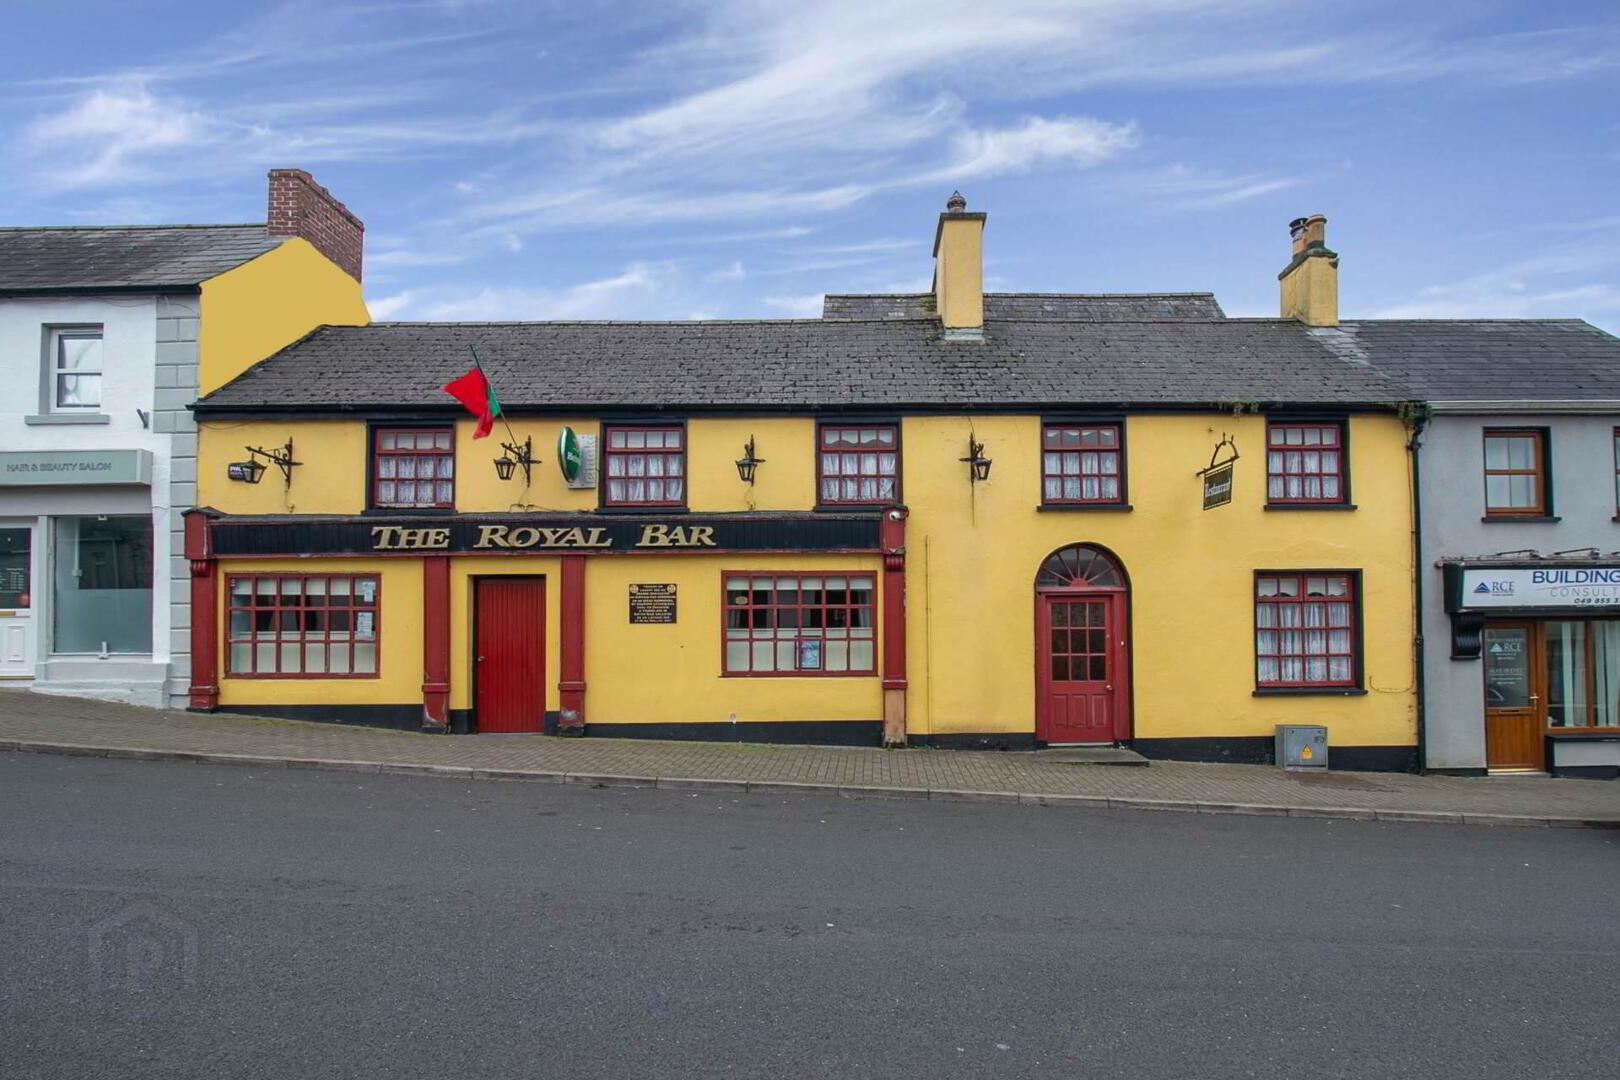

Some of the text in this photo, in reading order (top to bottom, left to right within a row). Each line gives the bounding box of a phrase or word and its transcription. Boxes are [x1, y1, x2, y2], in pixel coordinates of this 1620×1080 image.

[6, 462, 112, 472] HAIR & BEAUTY SALON
[371, 524, 716, 549] THE ROYAL BAR
[1532, 571, 1620, 584] BUILDING
[1492, 581, 1515, 592] RCE
